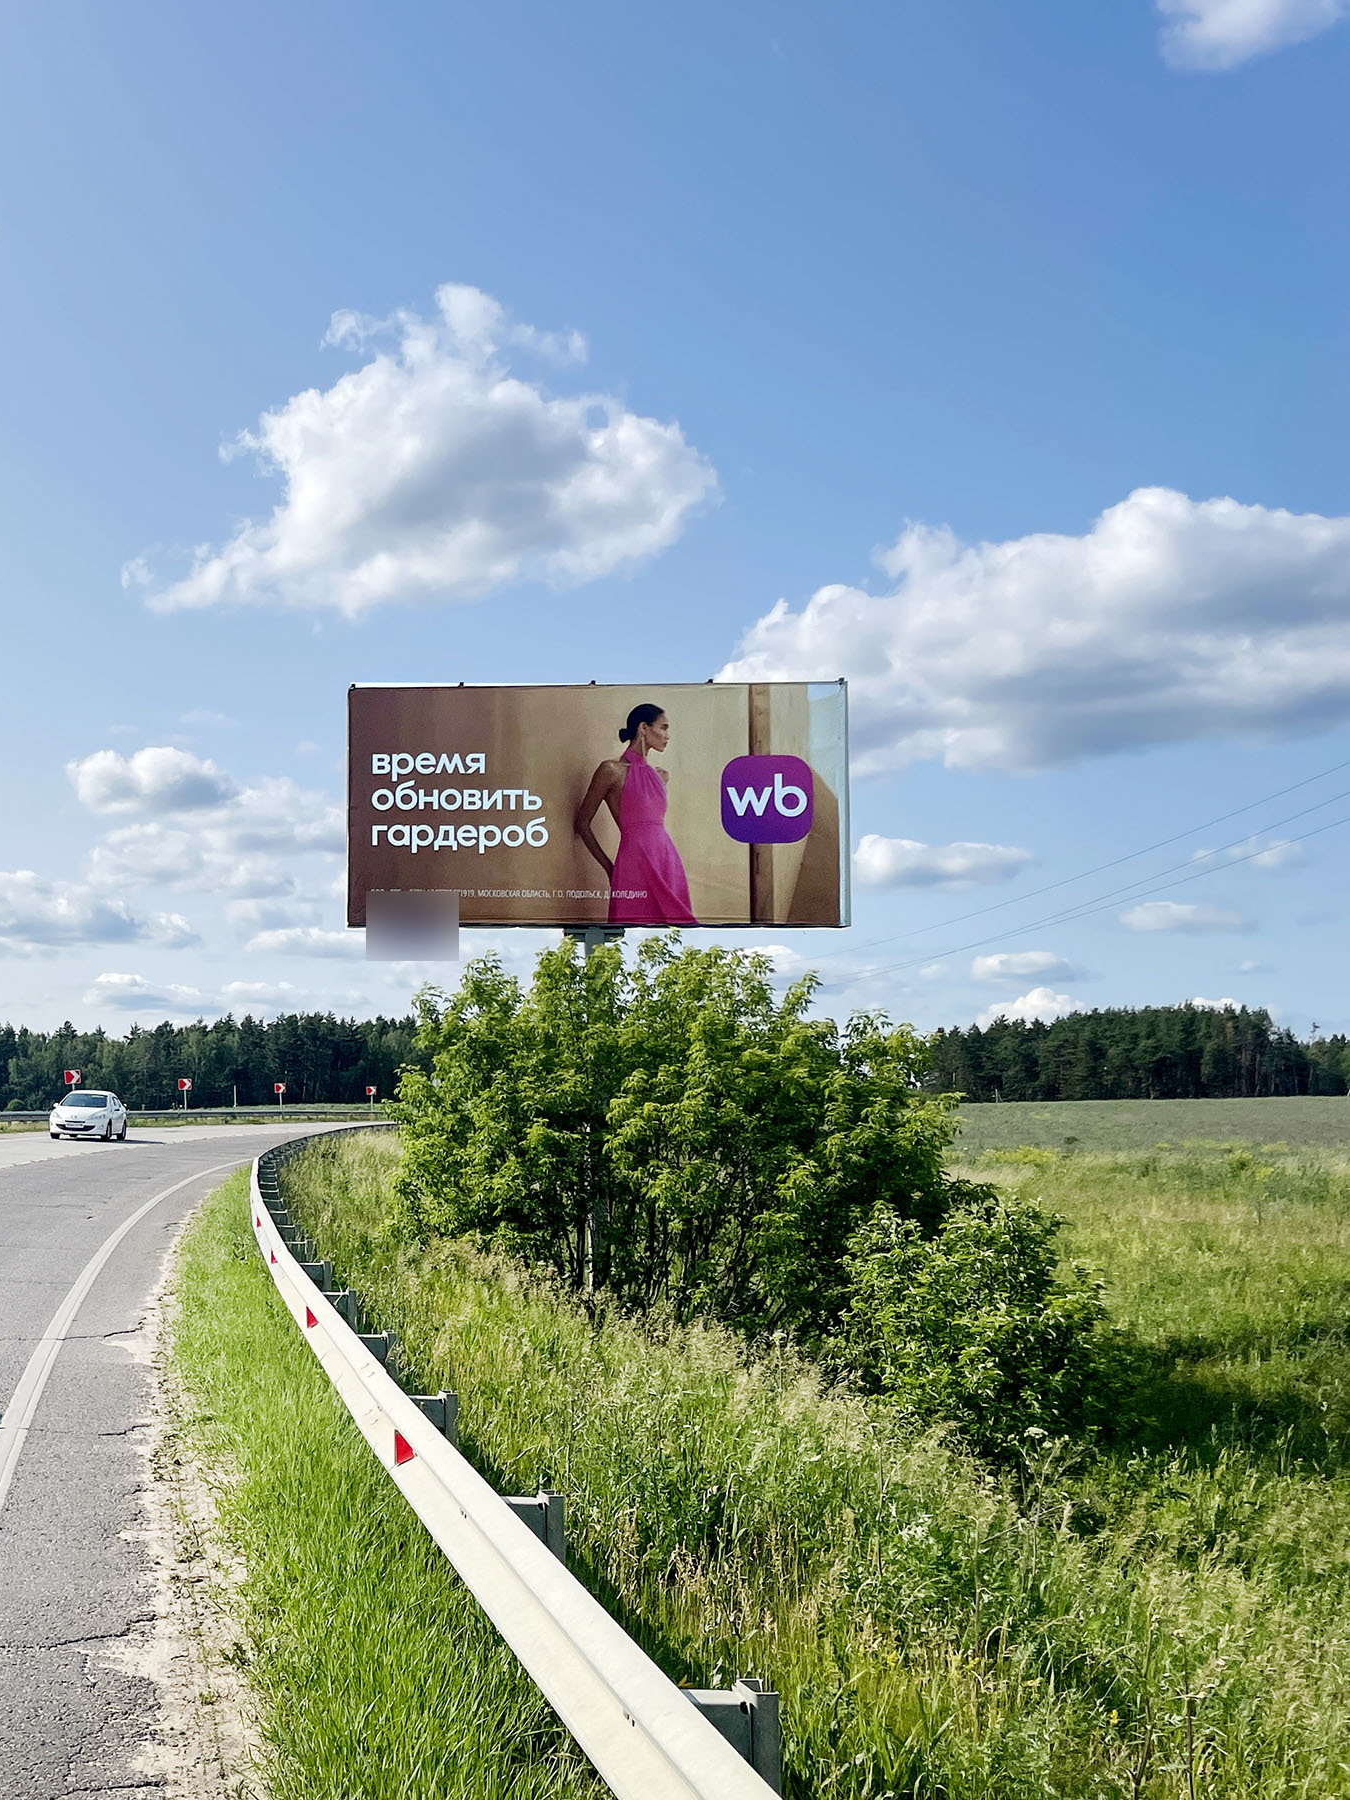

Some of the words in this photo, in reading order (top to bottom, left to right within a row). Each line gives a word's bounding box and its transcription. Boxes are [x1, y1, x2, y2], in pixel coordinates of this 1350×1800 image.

[371, 752, 486, 782] время
[371, 780, 543, 812] обновить
[726, 773, 808, 818] wb
[371, 817, 549, 854] гардероб
[477, 888, 520, 898] МОСКОВСКАЯ
[612, 889, 648, 899] КОЛЕДИНО
